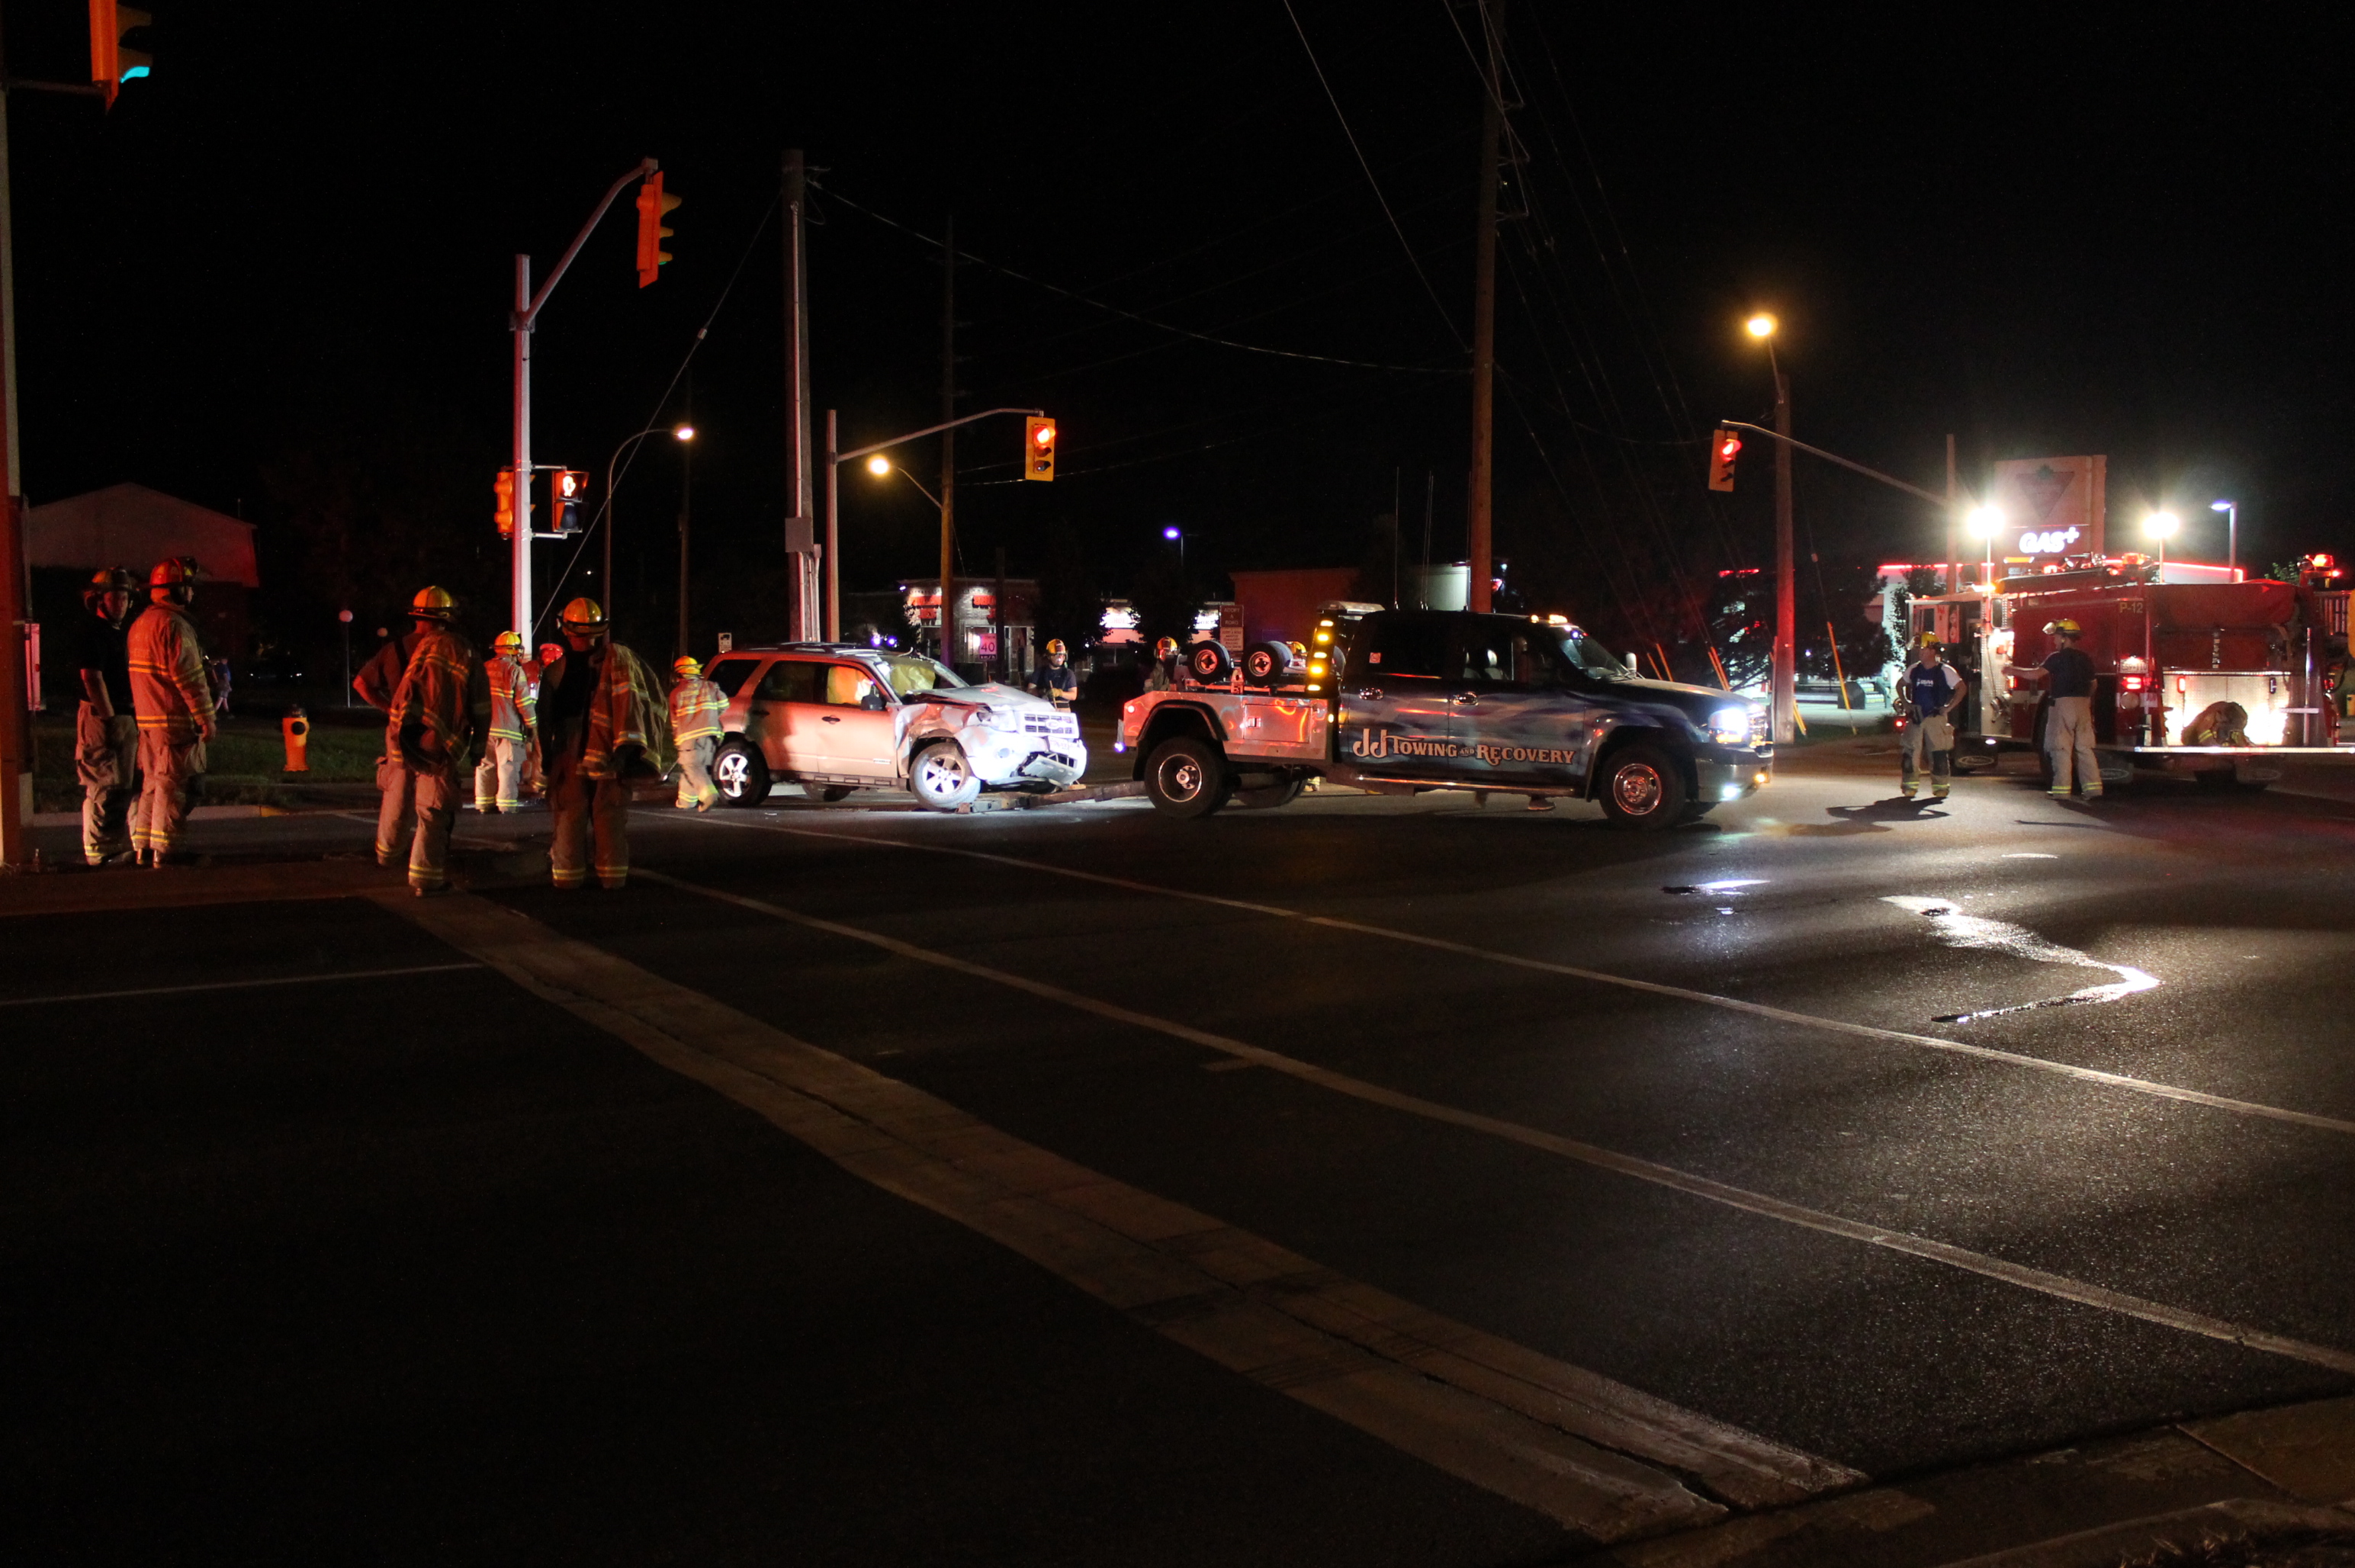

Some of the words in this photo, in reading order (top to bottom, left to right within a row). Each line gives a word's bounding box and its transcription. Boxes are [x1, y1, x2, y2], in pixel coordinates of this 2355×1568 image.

[2119, 602, 2144, 613] P-12
[981, 642, 995, 652] 40
[1383, 734, 1458, 757] TOWING
[1460, 747, 1475, 756] AND
[1476, 744, 1576, 766] RECOVERY
